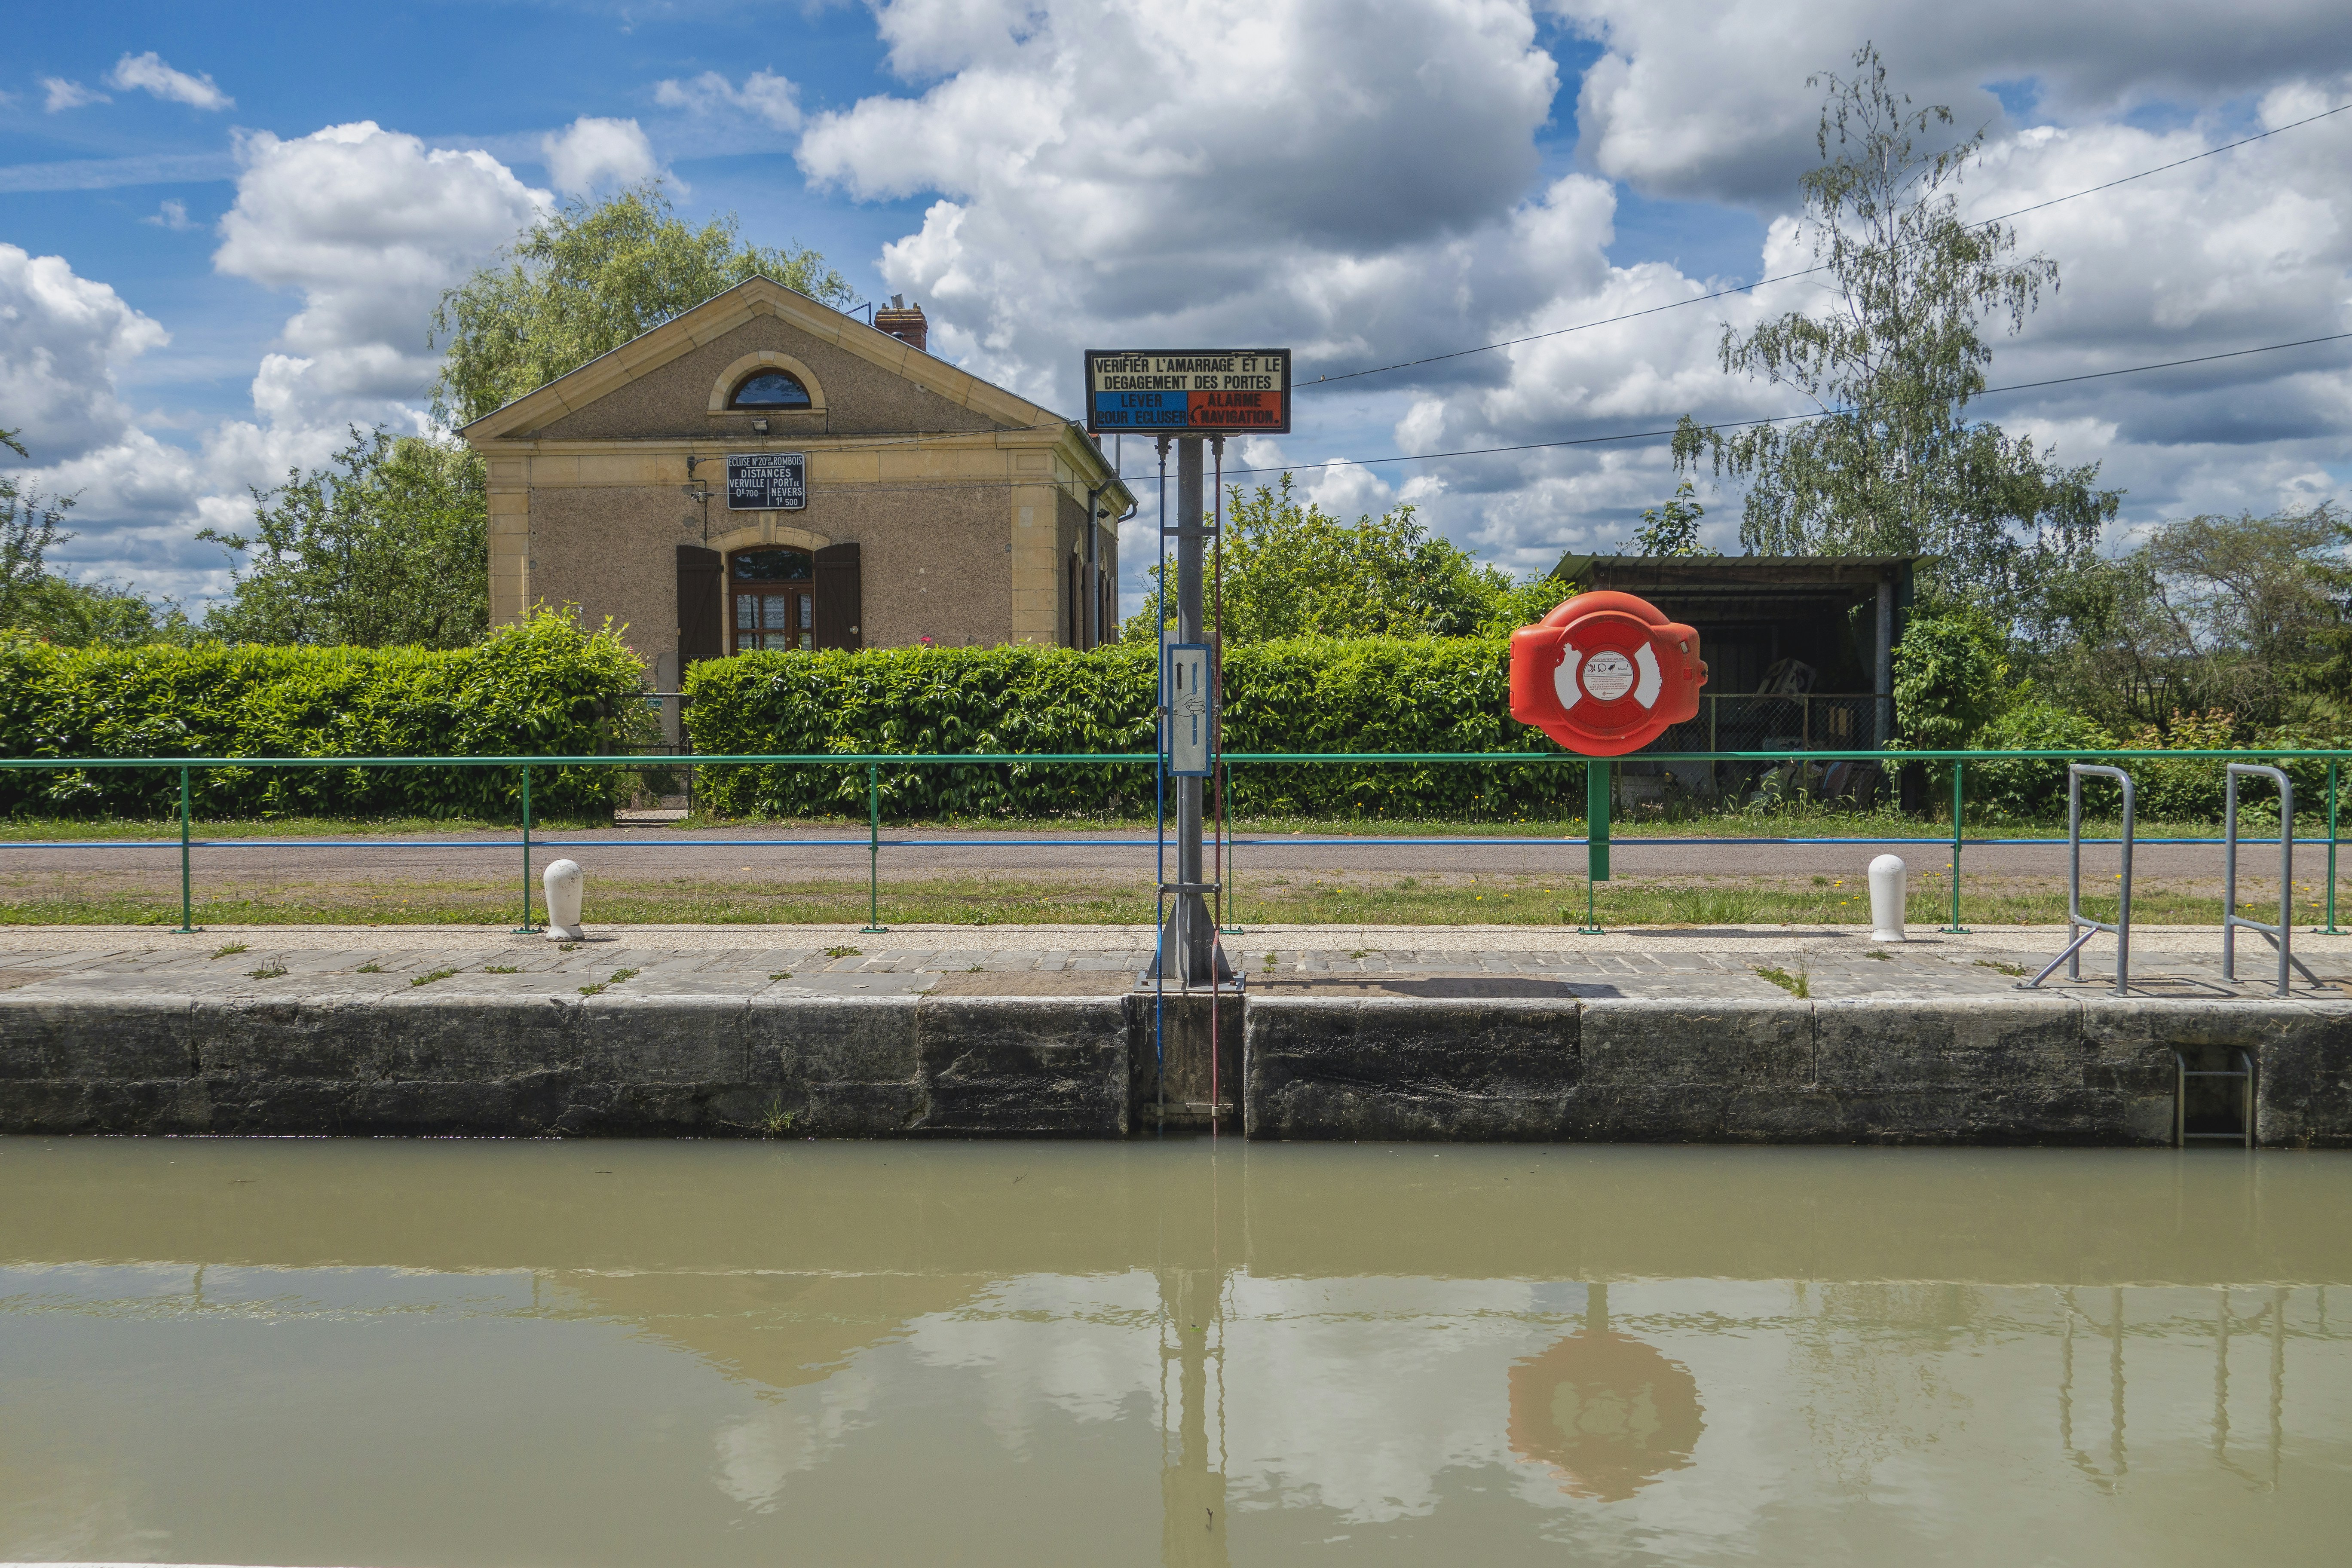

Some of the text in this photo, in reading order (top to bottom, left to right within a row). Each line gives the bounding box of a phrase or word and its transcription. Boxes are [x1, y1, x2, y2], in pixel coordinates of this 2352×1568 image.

[1095, 358, 1280, 373] VERIFIER L'AMARRAGE ET LE
[1105, 375, 1271, 389] DEGAGEMENT DES PORTES
[1121, 394, 1162, 407] LEVER
[1208, 393, 1261, 407] ALARME
[1097, 410, 1186, 424] POUR ECLUSER
[729, 457, 750, 466] ECLUSE
[774, 456, 802, 465] ROMBOIS
[741, 469, 791, 478] DISTANCES
[729, 479, 764, 487] VERVILLE
[773, 478, 793, 487] PORT
[772, 487, 802, 496] NEVERS
